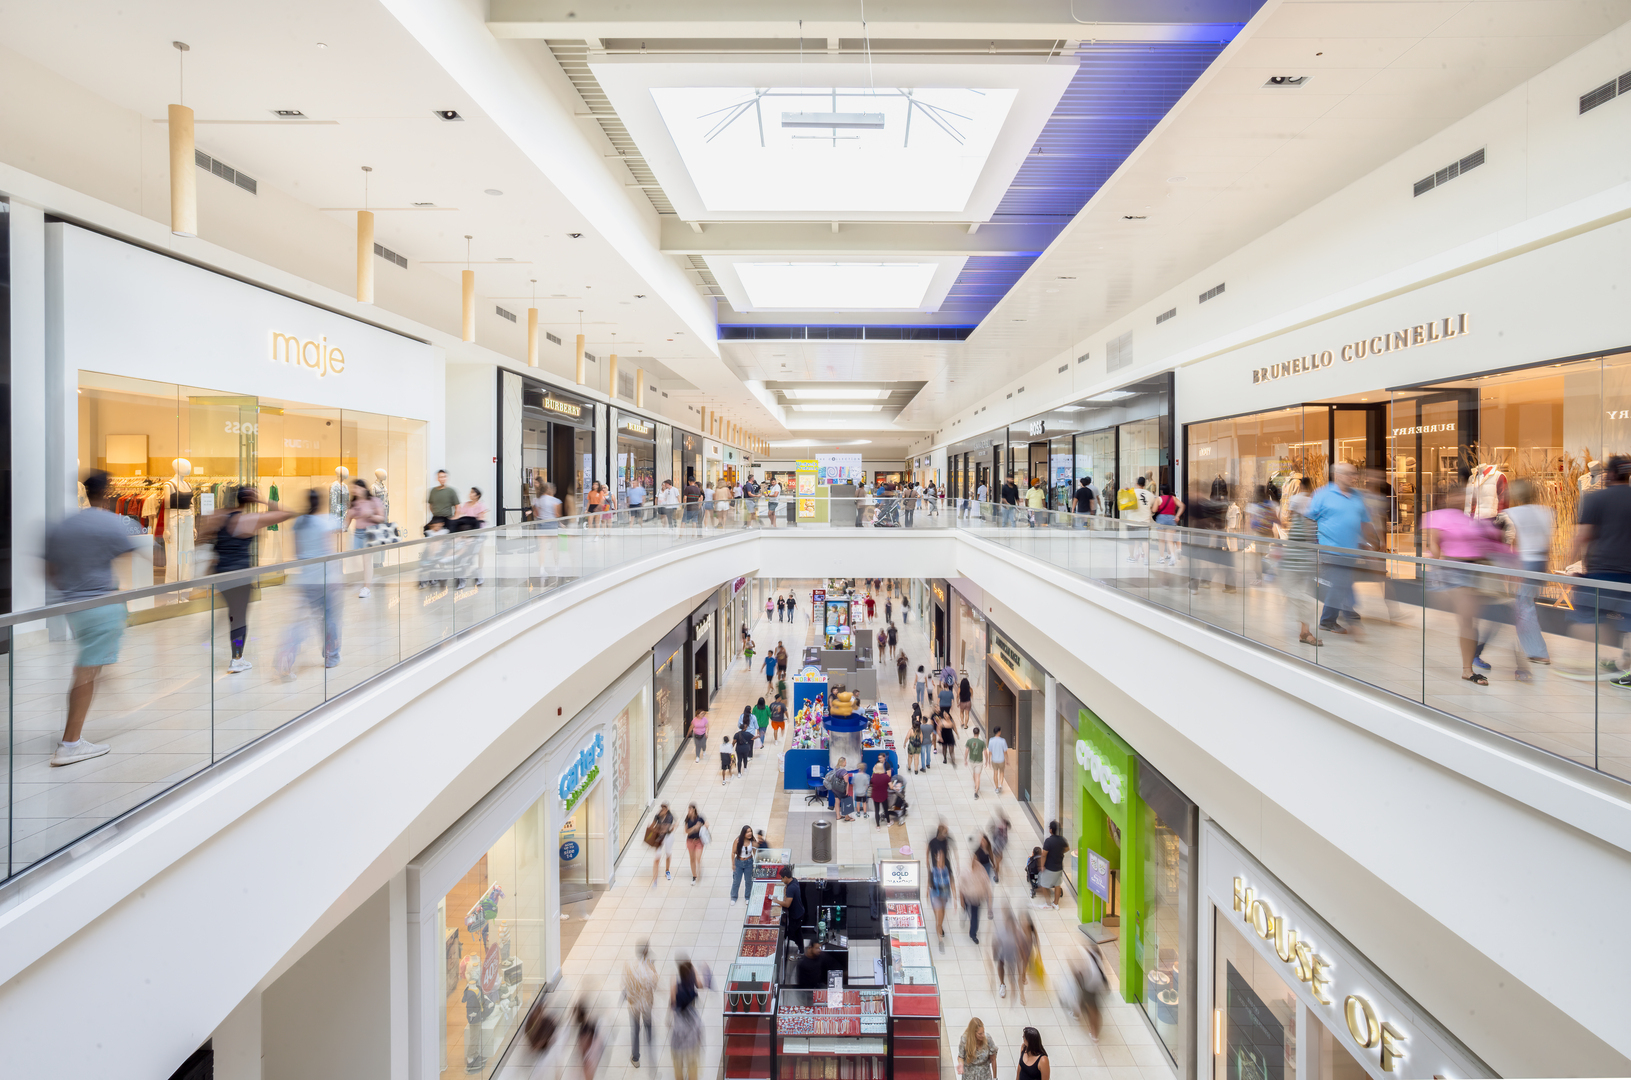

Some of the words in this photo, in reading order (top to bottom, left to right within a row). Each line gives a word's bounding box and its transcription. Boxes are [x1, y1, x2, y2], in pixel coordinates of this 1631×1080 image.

[272, 331, 346, 378] maje
[1252, 350, 1334, 385] BRUNELLO
[1341, 313, 1470, 362] CUCINELLI
[544, 398, 581, 417] BURBERRY
[628, 422, 649, 434] BURBERRY
[1030, 420, 1045, 437] BOSS
[559, 732, 604, 800] carter's
[1076, 739, 1126, 804] crocs
[1233, 876, 1330, 1005] HOUSE
[1343, 994, 1407, 1072] OF
